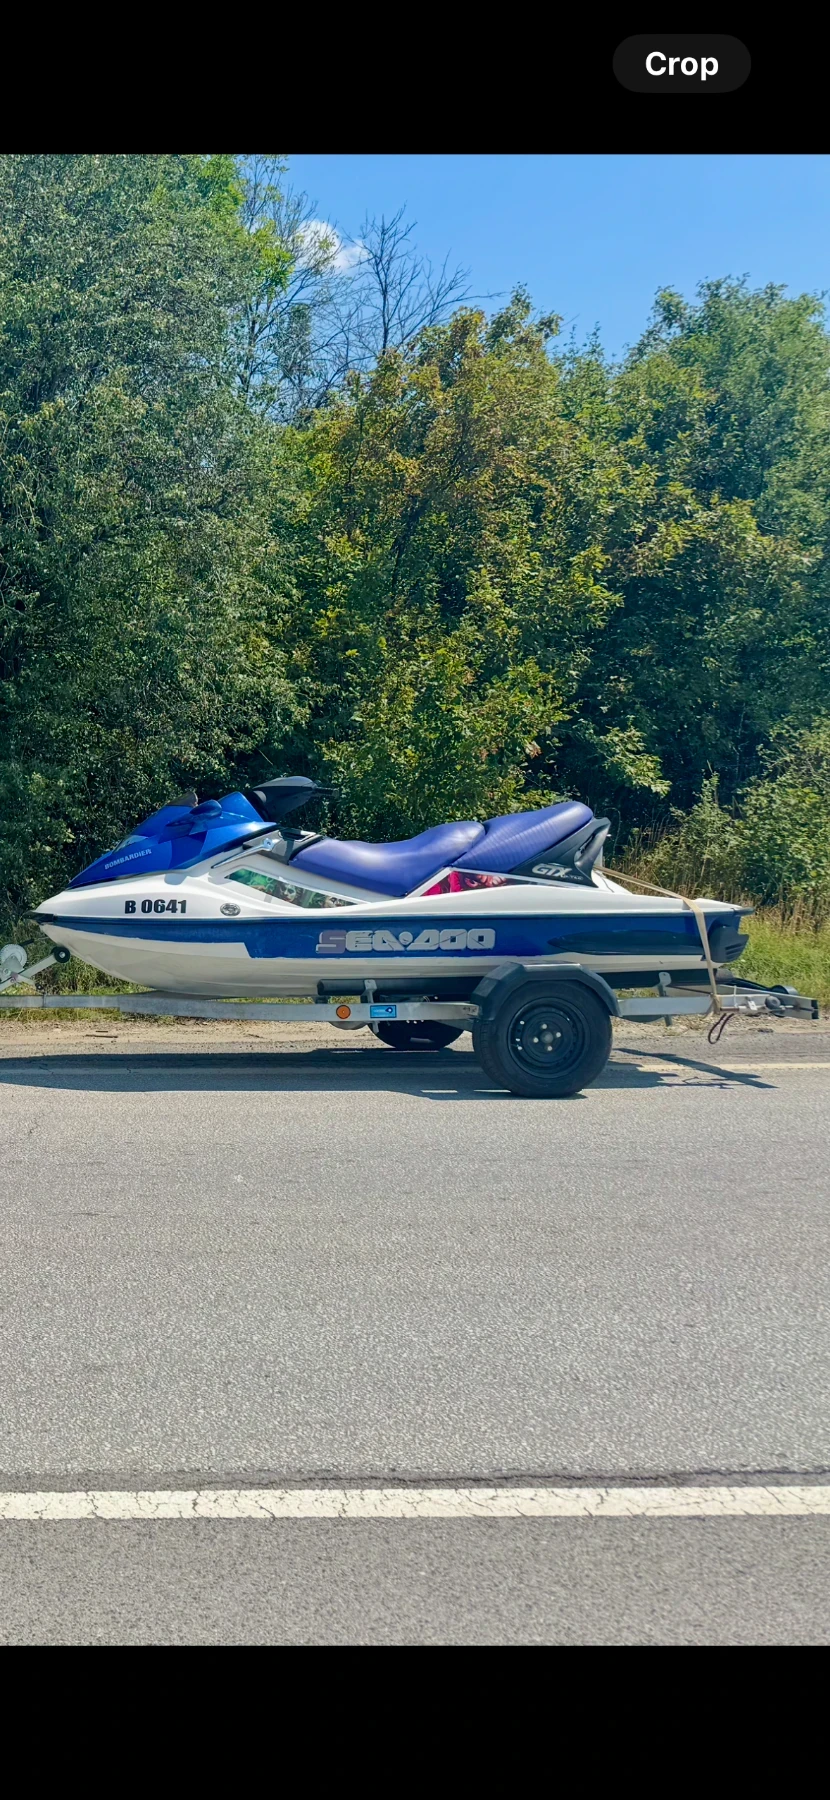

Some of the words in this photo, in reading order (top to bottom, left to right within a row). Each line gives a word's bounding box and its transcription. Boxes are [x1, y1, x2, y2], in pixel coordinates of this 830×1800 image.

[104, 848, 152, 870] BOMBARDIER
[532, 862, 572, 878] GTX
[124, 900, 136, 914] B
[141, 899, 187, 914] 0641
